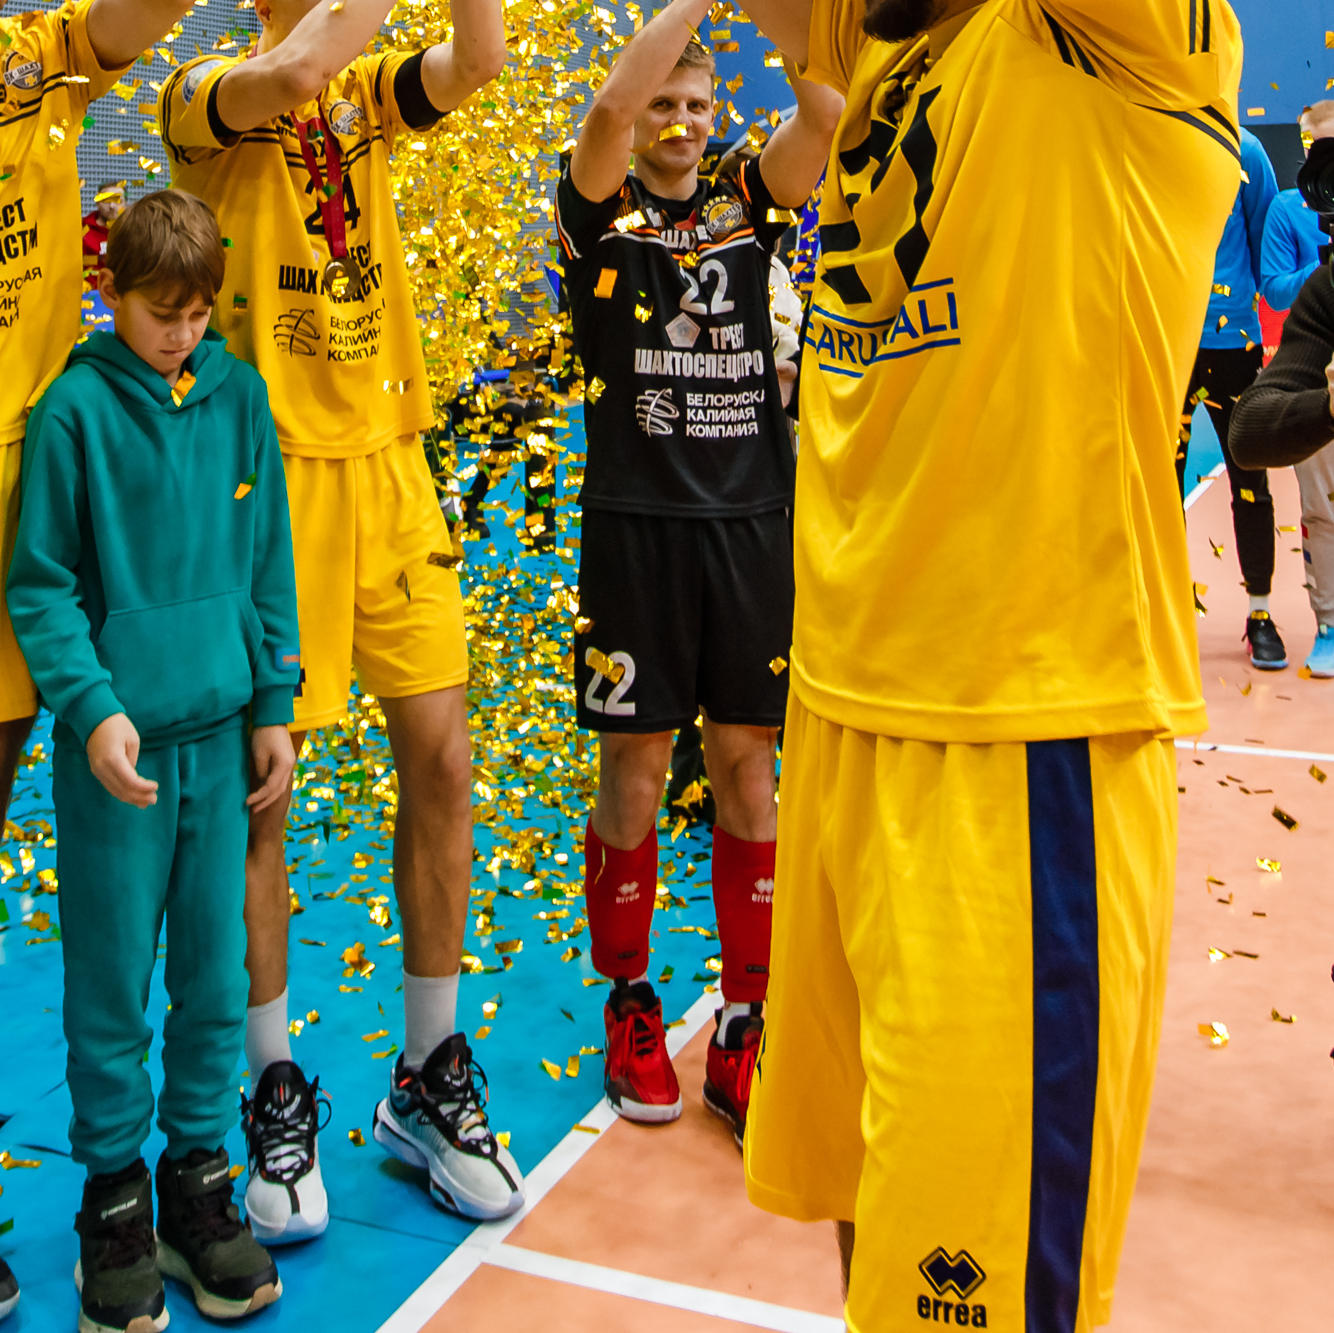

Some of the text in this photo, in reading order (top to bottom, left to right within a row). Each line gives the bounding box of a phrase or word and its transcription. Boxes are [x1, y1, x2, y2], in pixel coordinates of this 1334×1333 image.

[17, 62, 39, 76] ШАХТ
[679, 259, 735, 315] 22
[709, 323, 744, 350] ТРЕСТ
[585, 647, 636, 716] 22
[917, 1294, 987, 1328] errea
